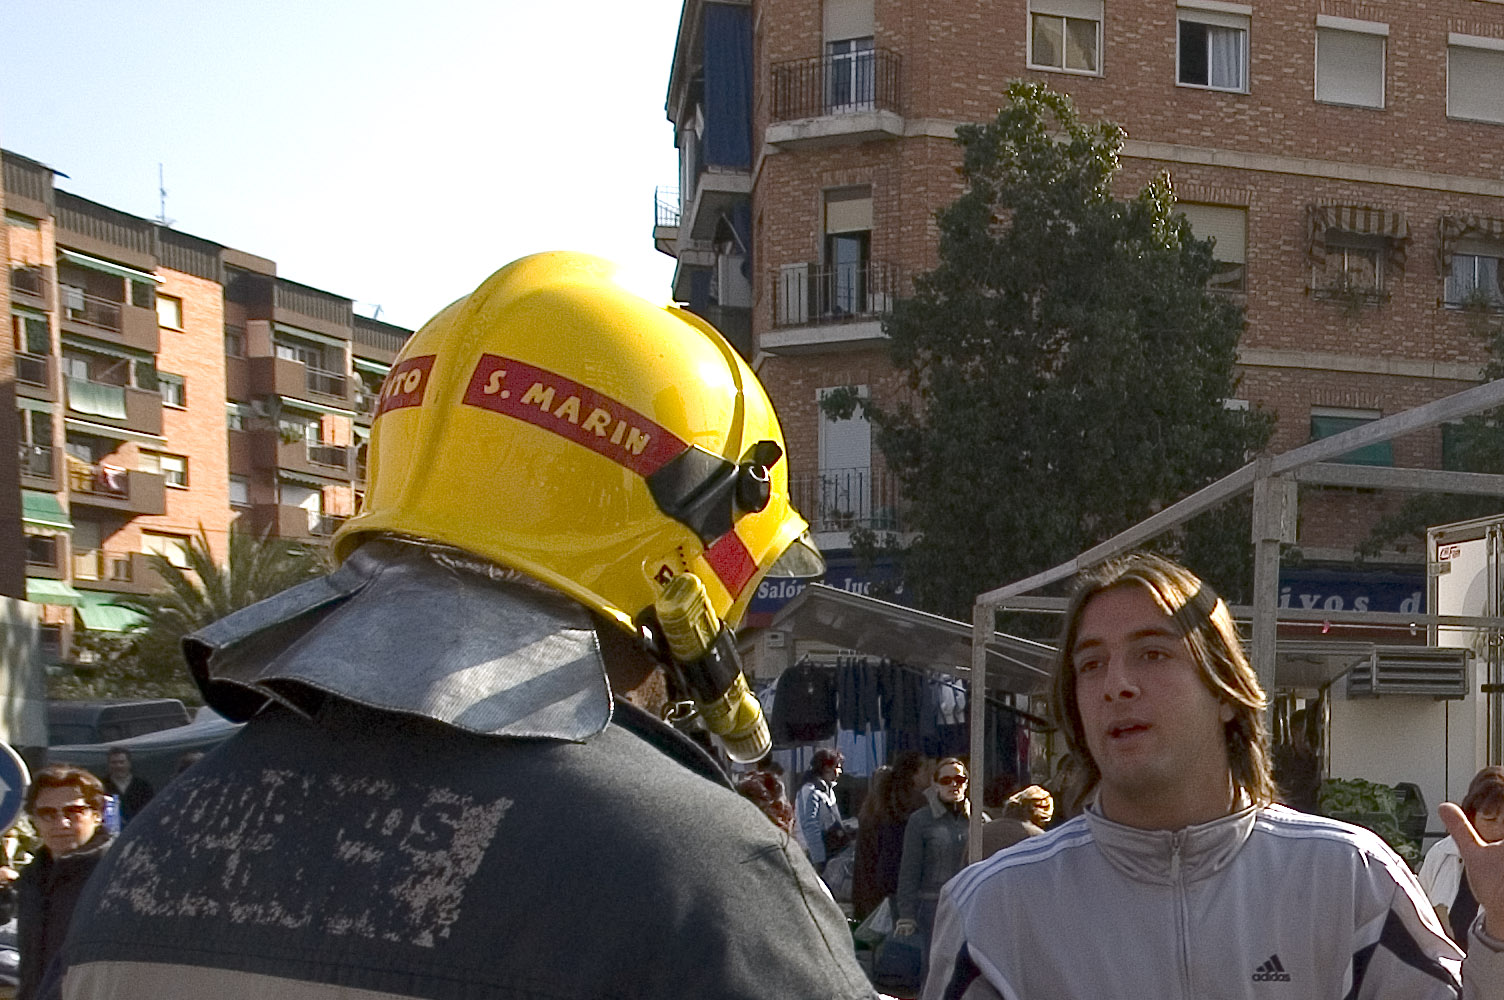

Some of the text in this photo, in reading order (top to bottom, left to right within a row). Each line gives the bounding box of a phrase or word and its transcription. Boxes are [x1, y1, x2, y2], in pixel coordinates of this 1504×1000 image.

[483, 369, 651, 456] S. MARIN
[1251, 971, 1292, 983] adidas
